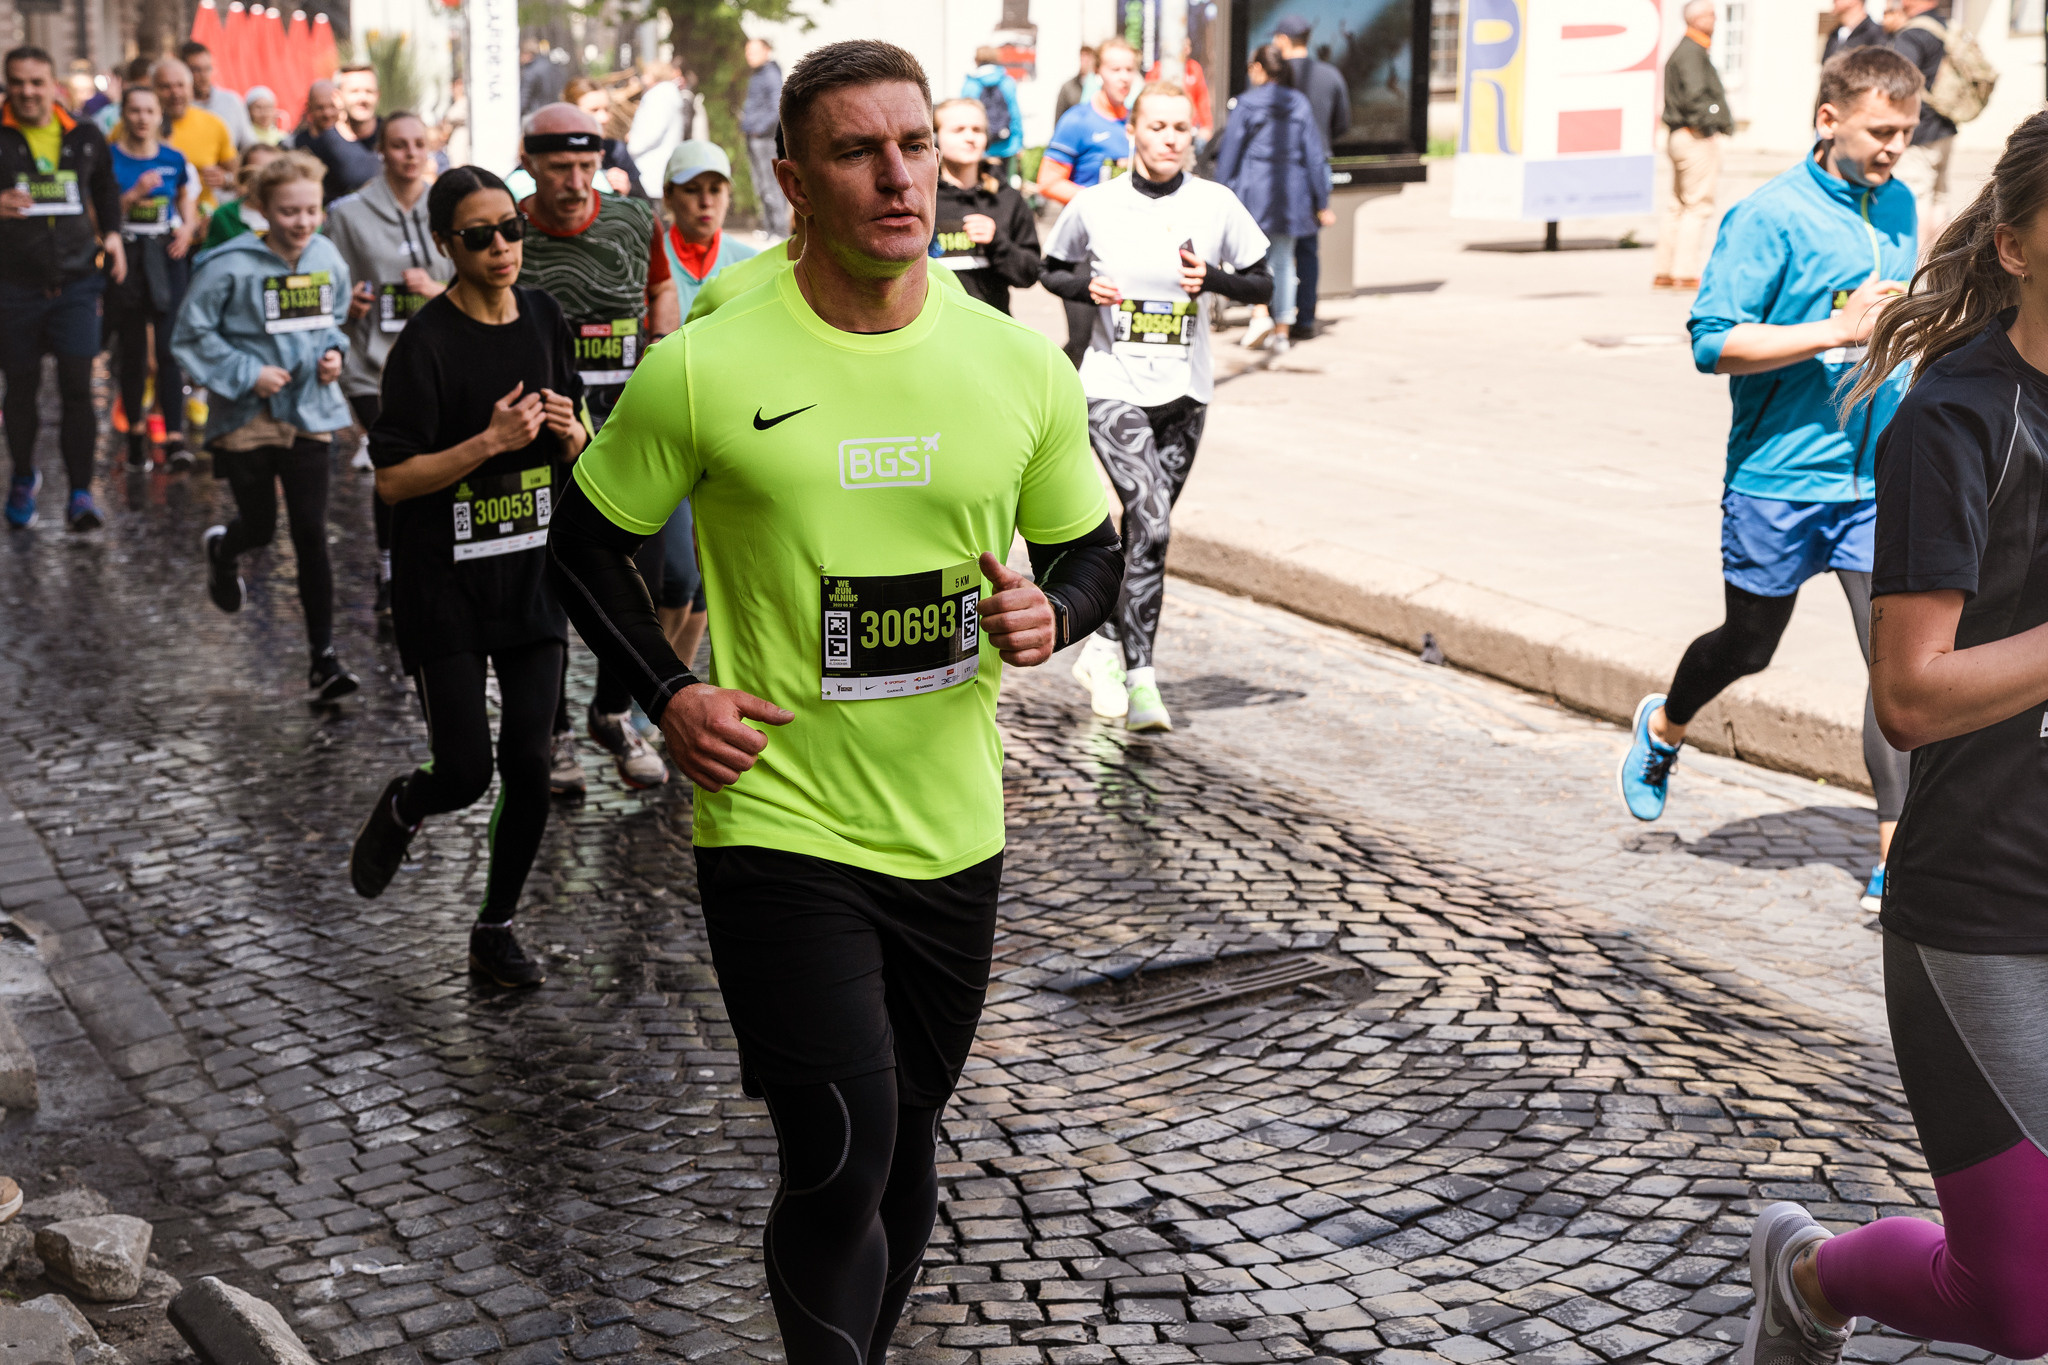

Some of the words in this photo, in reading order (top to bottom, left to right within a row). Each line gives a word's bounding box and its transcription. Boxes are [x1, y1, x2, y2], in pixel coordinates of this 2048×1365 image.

[849, 445, 920, 479] BGS
[474, 491, 534, 525] 30053
[828, 594, 858, 602] VILNIUS
[954, 577, 960, 589] 5
[960, 575, 970, 587] KM
[860, 600, 956, 649] 30693
